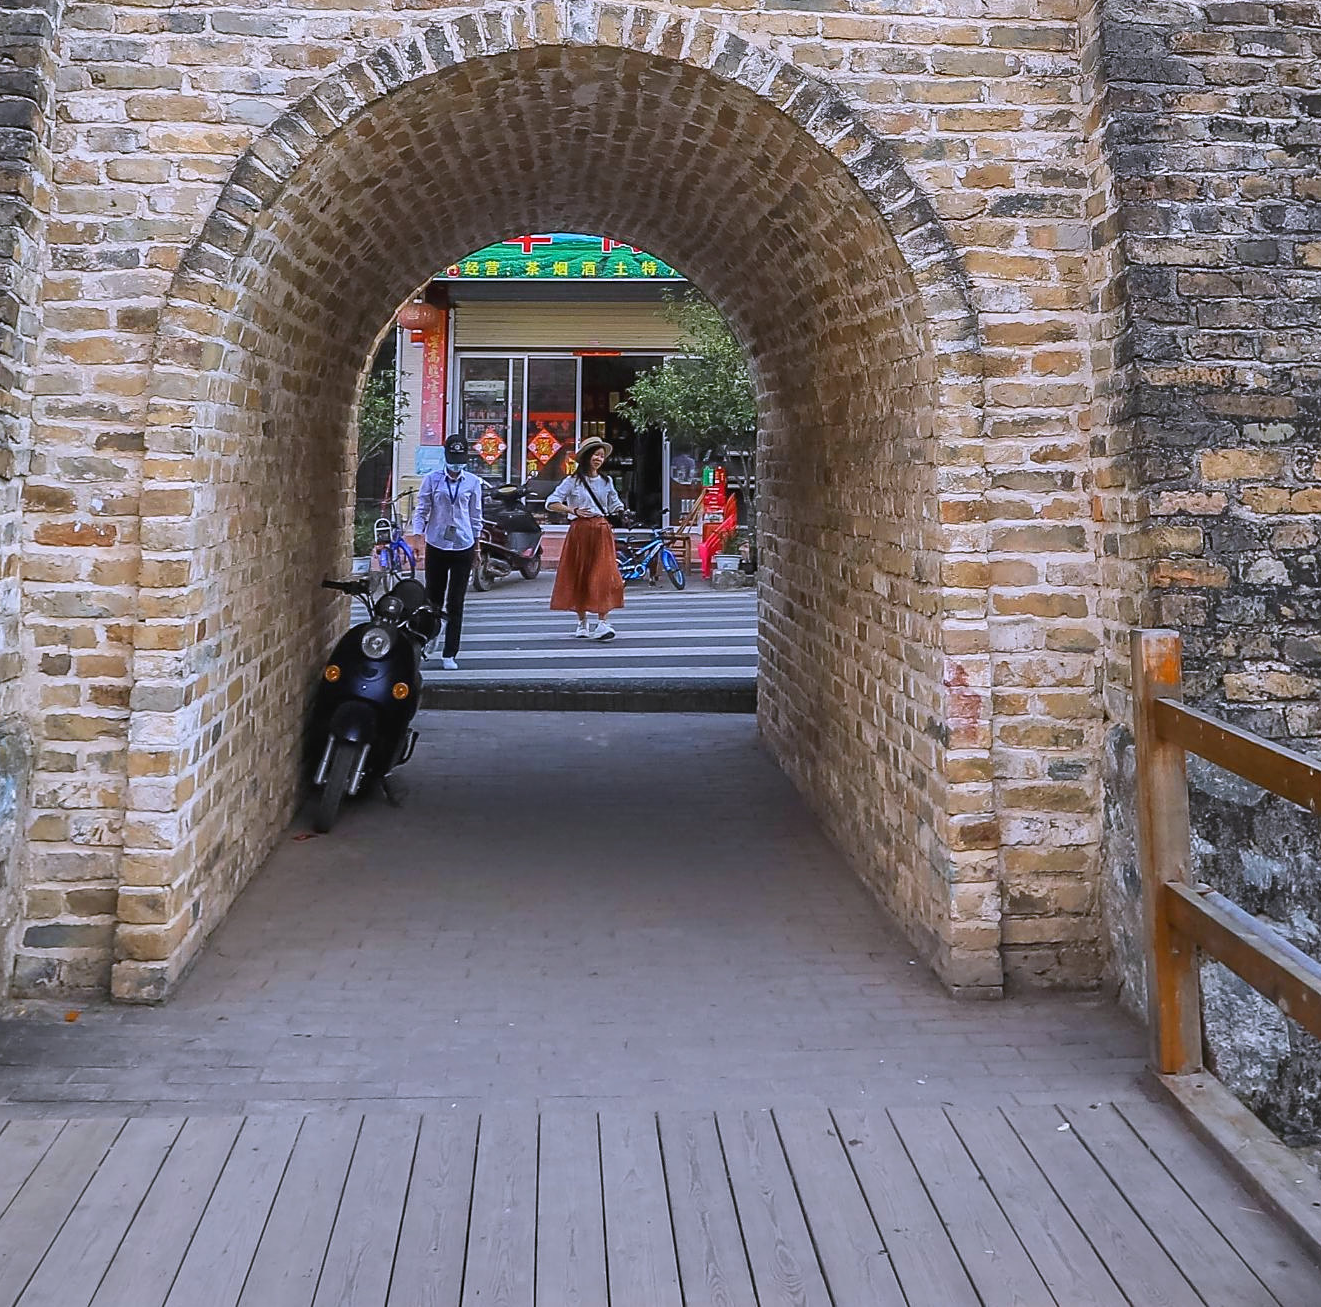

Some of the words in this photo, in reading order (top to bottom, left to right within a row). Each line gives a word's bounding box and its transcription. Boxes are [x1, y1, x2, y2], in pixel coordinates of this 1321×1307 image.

[464, 260, 676, 277] 经营：茶烟酒土特
